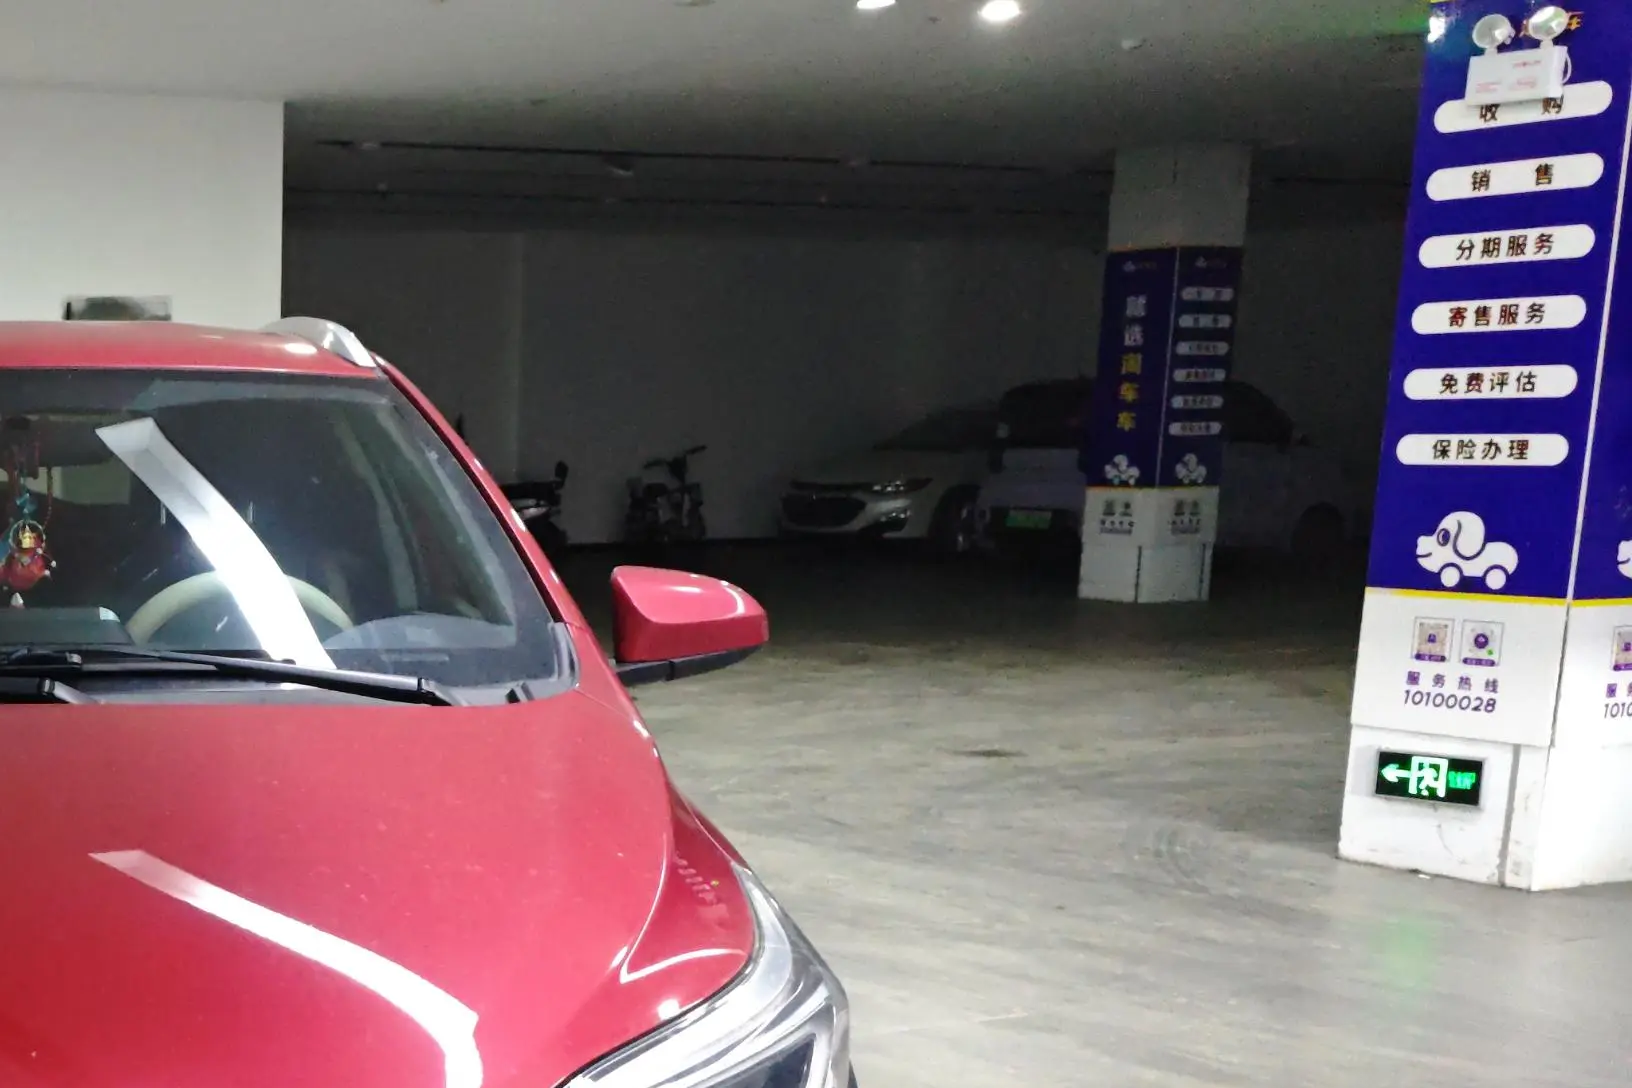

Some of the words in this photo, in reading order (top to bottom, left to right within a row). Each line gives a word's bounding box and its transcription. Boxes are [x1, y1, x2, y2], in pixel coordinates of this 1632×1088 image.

[1471, 163, 1555, 192] 销售
[1455, 233, 1555, 261] 分期服务
[1447, 302, 1546, 328] 寄售服务
[1439, 370, 1537, 394] 免费评估
[1431, 439, 1530, 461] 保险办理
[1404, 690, 1497, 714] 10100028
